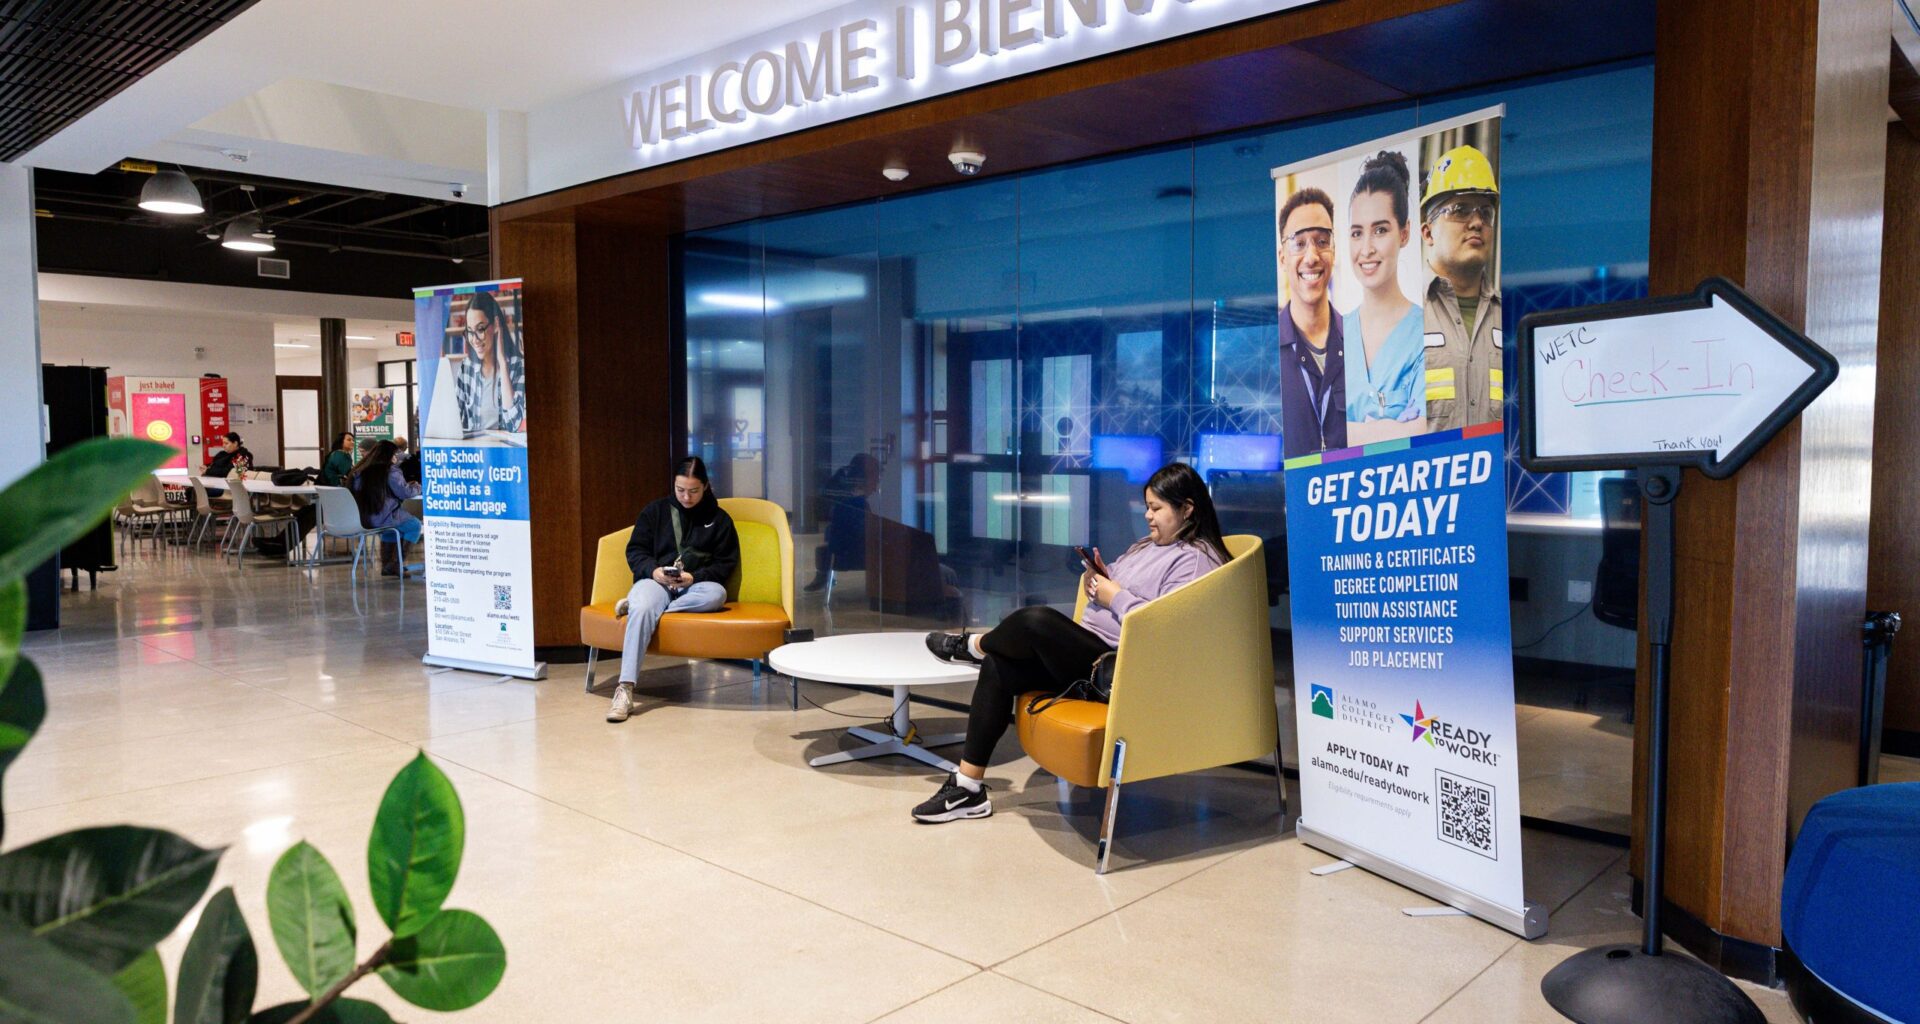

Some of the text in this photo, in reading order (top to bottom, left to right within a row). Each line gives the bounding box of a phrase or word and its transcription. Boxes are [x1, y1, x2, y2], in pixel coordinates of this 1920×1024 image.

[621, 19, 878, 149] WELCOME
[400, 336, 412, 344] EXIT
[1539, 326, 1597, 365] WETC
[1562, 338, 1754, 402] Check-In
[140, 380, 175, 391] just baked
[1653, 436, 1696, 450] Thank
[424, 450, 484, 466] High School
[425, 465, 484, 482] Equivalency
[1307, 450, 1492, 505] GET STARTED
[426, 480, 490, 497] /English as a
[427, 496, 506, 515] Second Langage
[1332, 493, 1459, 543] TODAY!
[1321, 545, 1475, 572] TRAINING & CERTIFICATES
[1334, 573, 1458, 595] DEGREE COMPLETION
[1336, 600, 1458, 619] TUITION ASSISTANCE
[1340, 626, 1453, 644] SUPPORT SERVICES
[1349, 651, 1443, 670] JOB PLACEMENT
[1342, 695, 1376, 710] ALAMO
[1342, 704, 1394, 724] COLLEGES
[1343, 713, 1391, 733] DISTRICT
[1431, 719, 1491, 748] READY
[1327, 742, 1409, 777] APPLY TODAY AT
[1434, 737, 1496, 766] TO WORK!
[1311, 756, 1430, 804] alamo.edu/readytowork
[1328, 780, 1411, 818] Eligibility requirements apply
